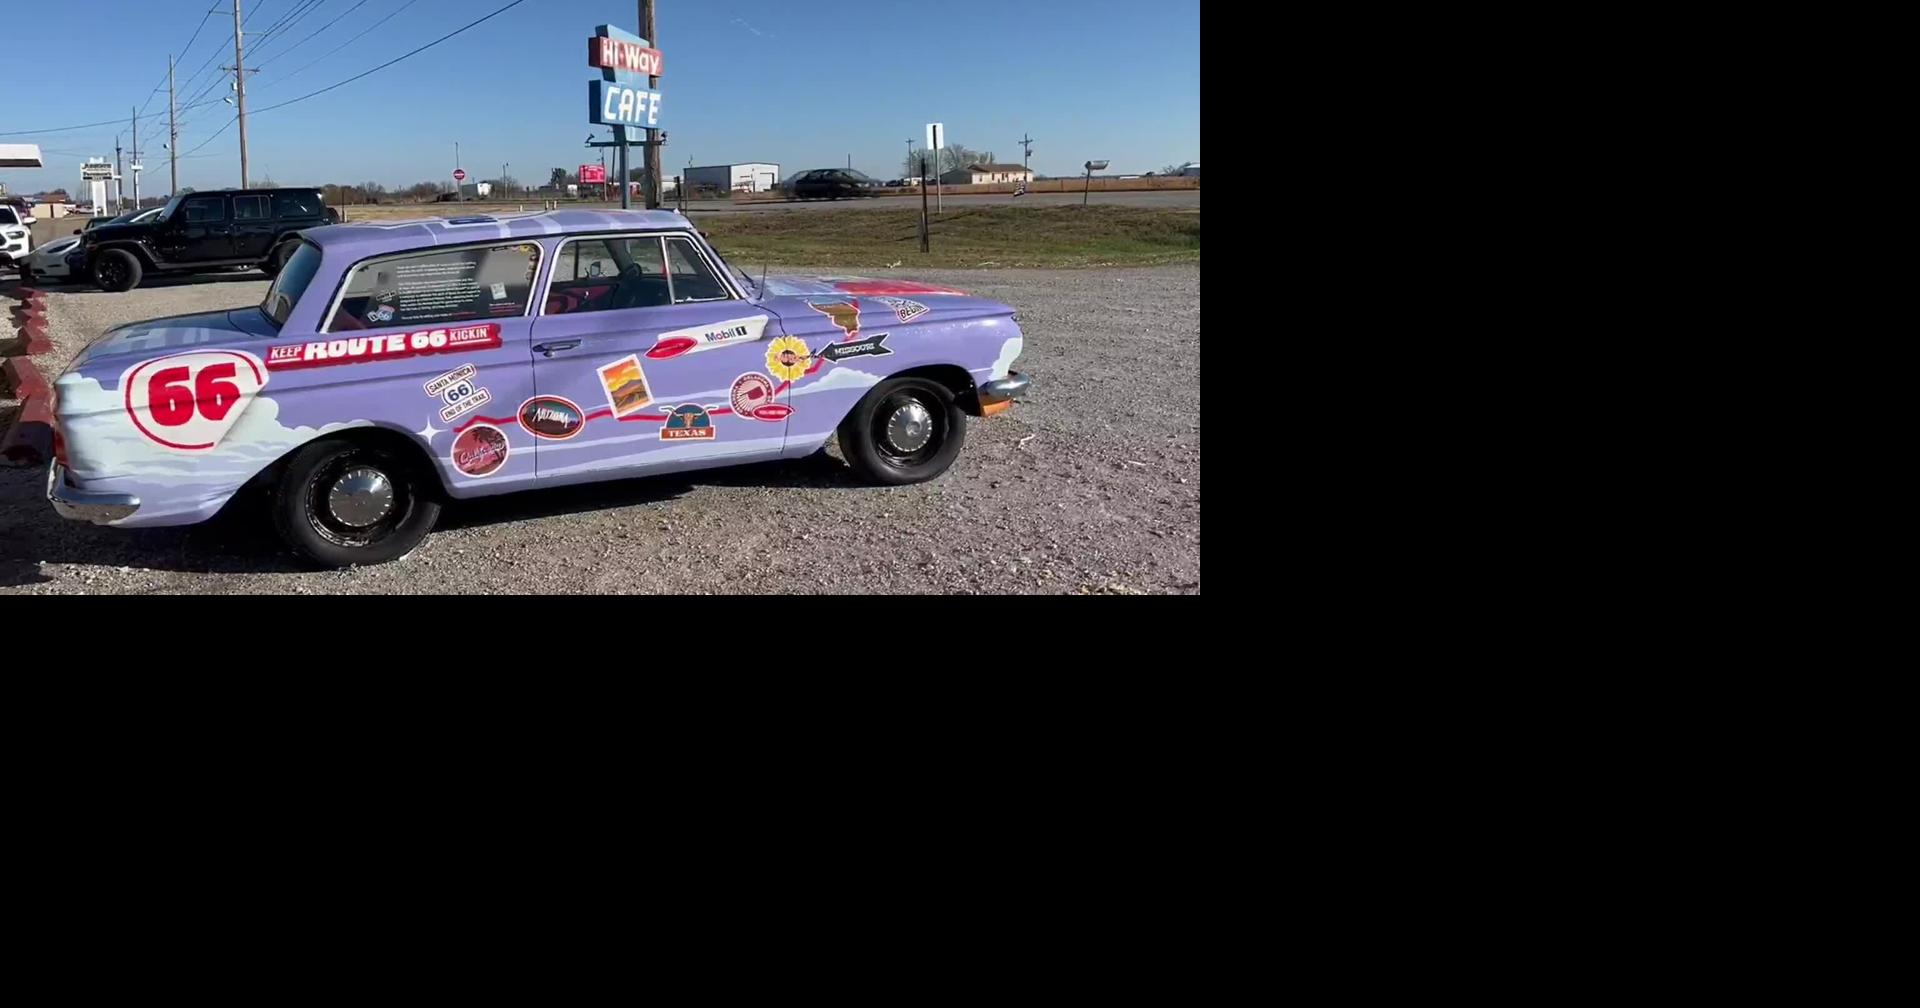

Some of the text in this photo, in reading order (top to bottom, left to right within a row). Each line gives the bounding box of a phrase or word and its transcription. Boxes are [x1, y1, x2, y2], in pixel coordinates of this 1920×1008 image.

[603, 86, 662, 125] CAFE
[271, 346, 302, 359] KEEP
[303, 333, 406, 361] ROUTE
[410, 329, 448, 349] 66
[704, 328, 736, 342] Mobil
[428, 367, 472, 393] SANTA MONICA
[447, 384, 469, 401] 66
[148, 362, 242, 427] 66
[667, 429, 706, 437] TEXAS
